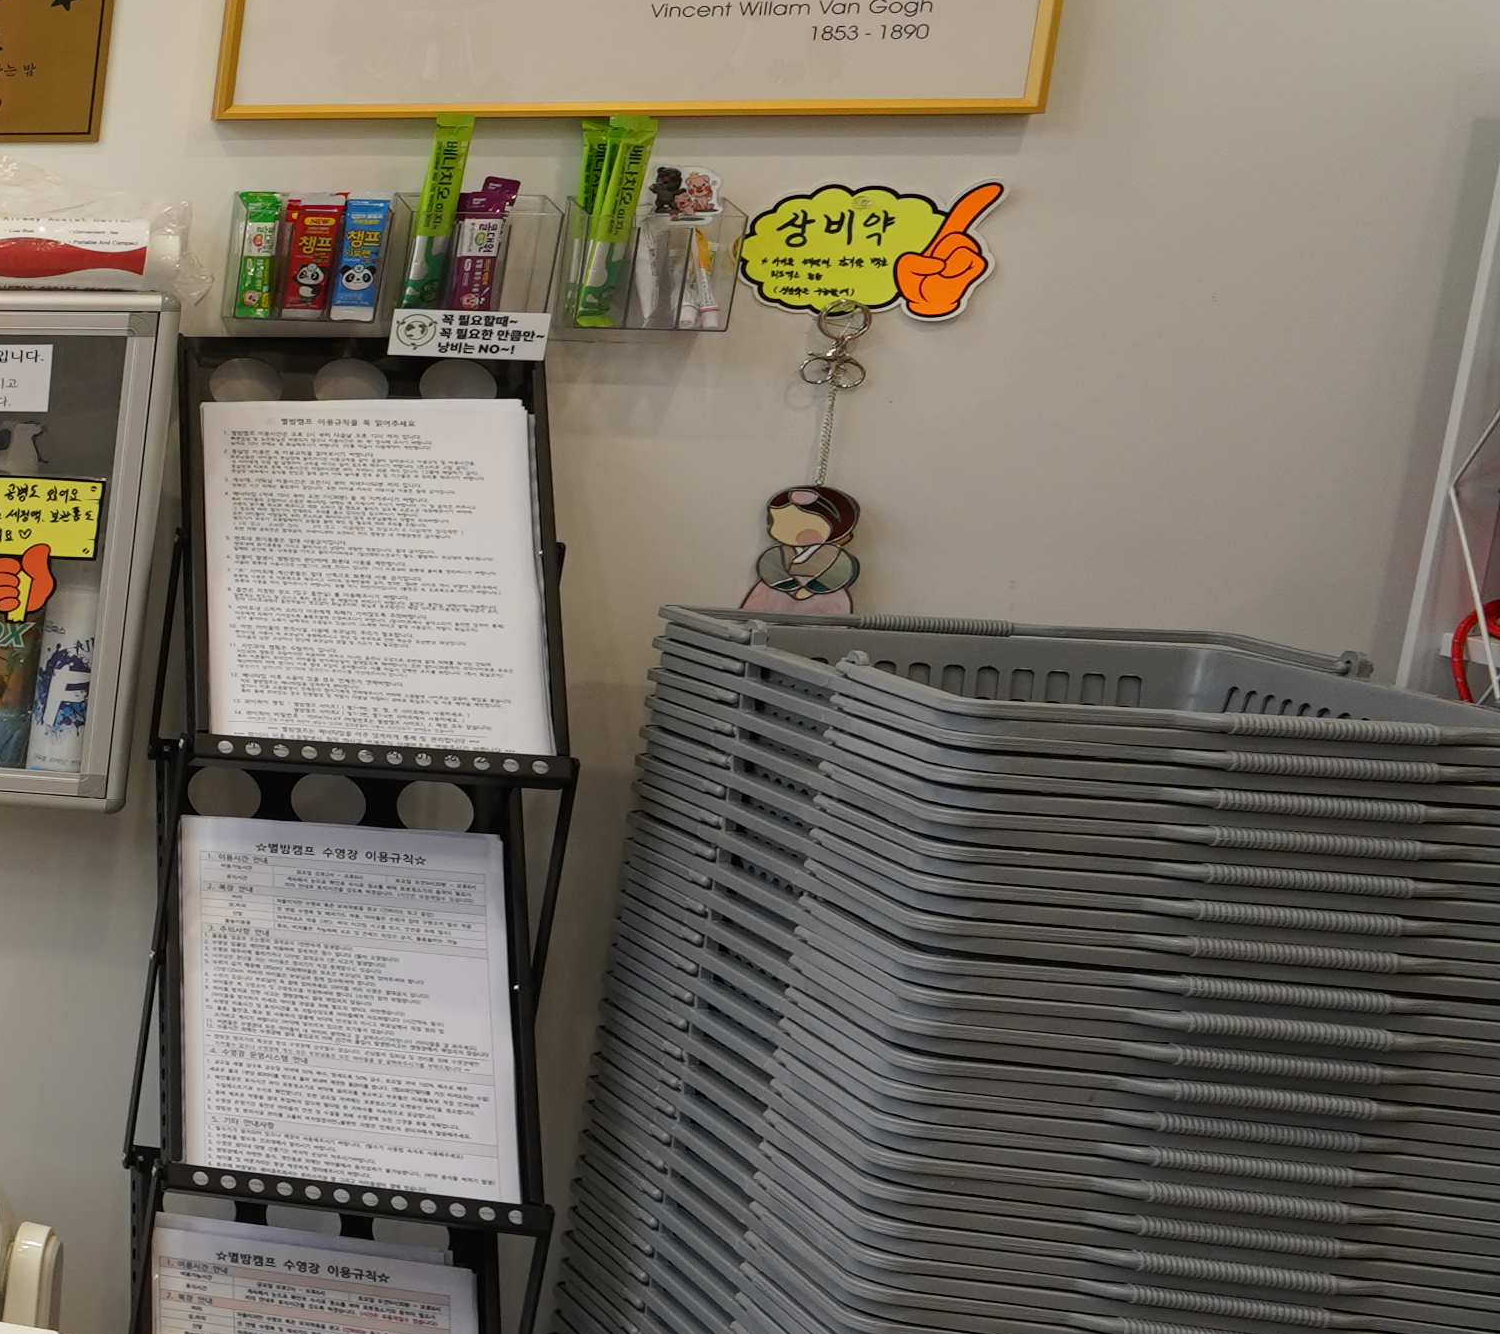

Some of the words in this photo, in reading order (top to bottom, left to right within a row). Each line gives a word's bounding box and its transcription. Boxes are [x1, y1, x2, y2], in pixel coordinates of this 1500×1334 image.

[650, 1, 733, 19] Vincent
[739, 0, 811, 17] Willam
[819, 0, 861, 16] Van
[810, 25, 860, 42] 1853
[878, 23, 930, 41] 1890
[23, 62, 37, 78] 밤
[346, 229, 382, 248] 챔프
[776, 209, 896, 249] 상비약
[298, 236, 333, 254] 챔프
